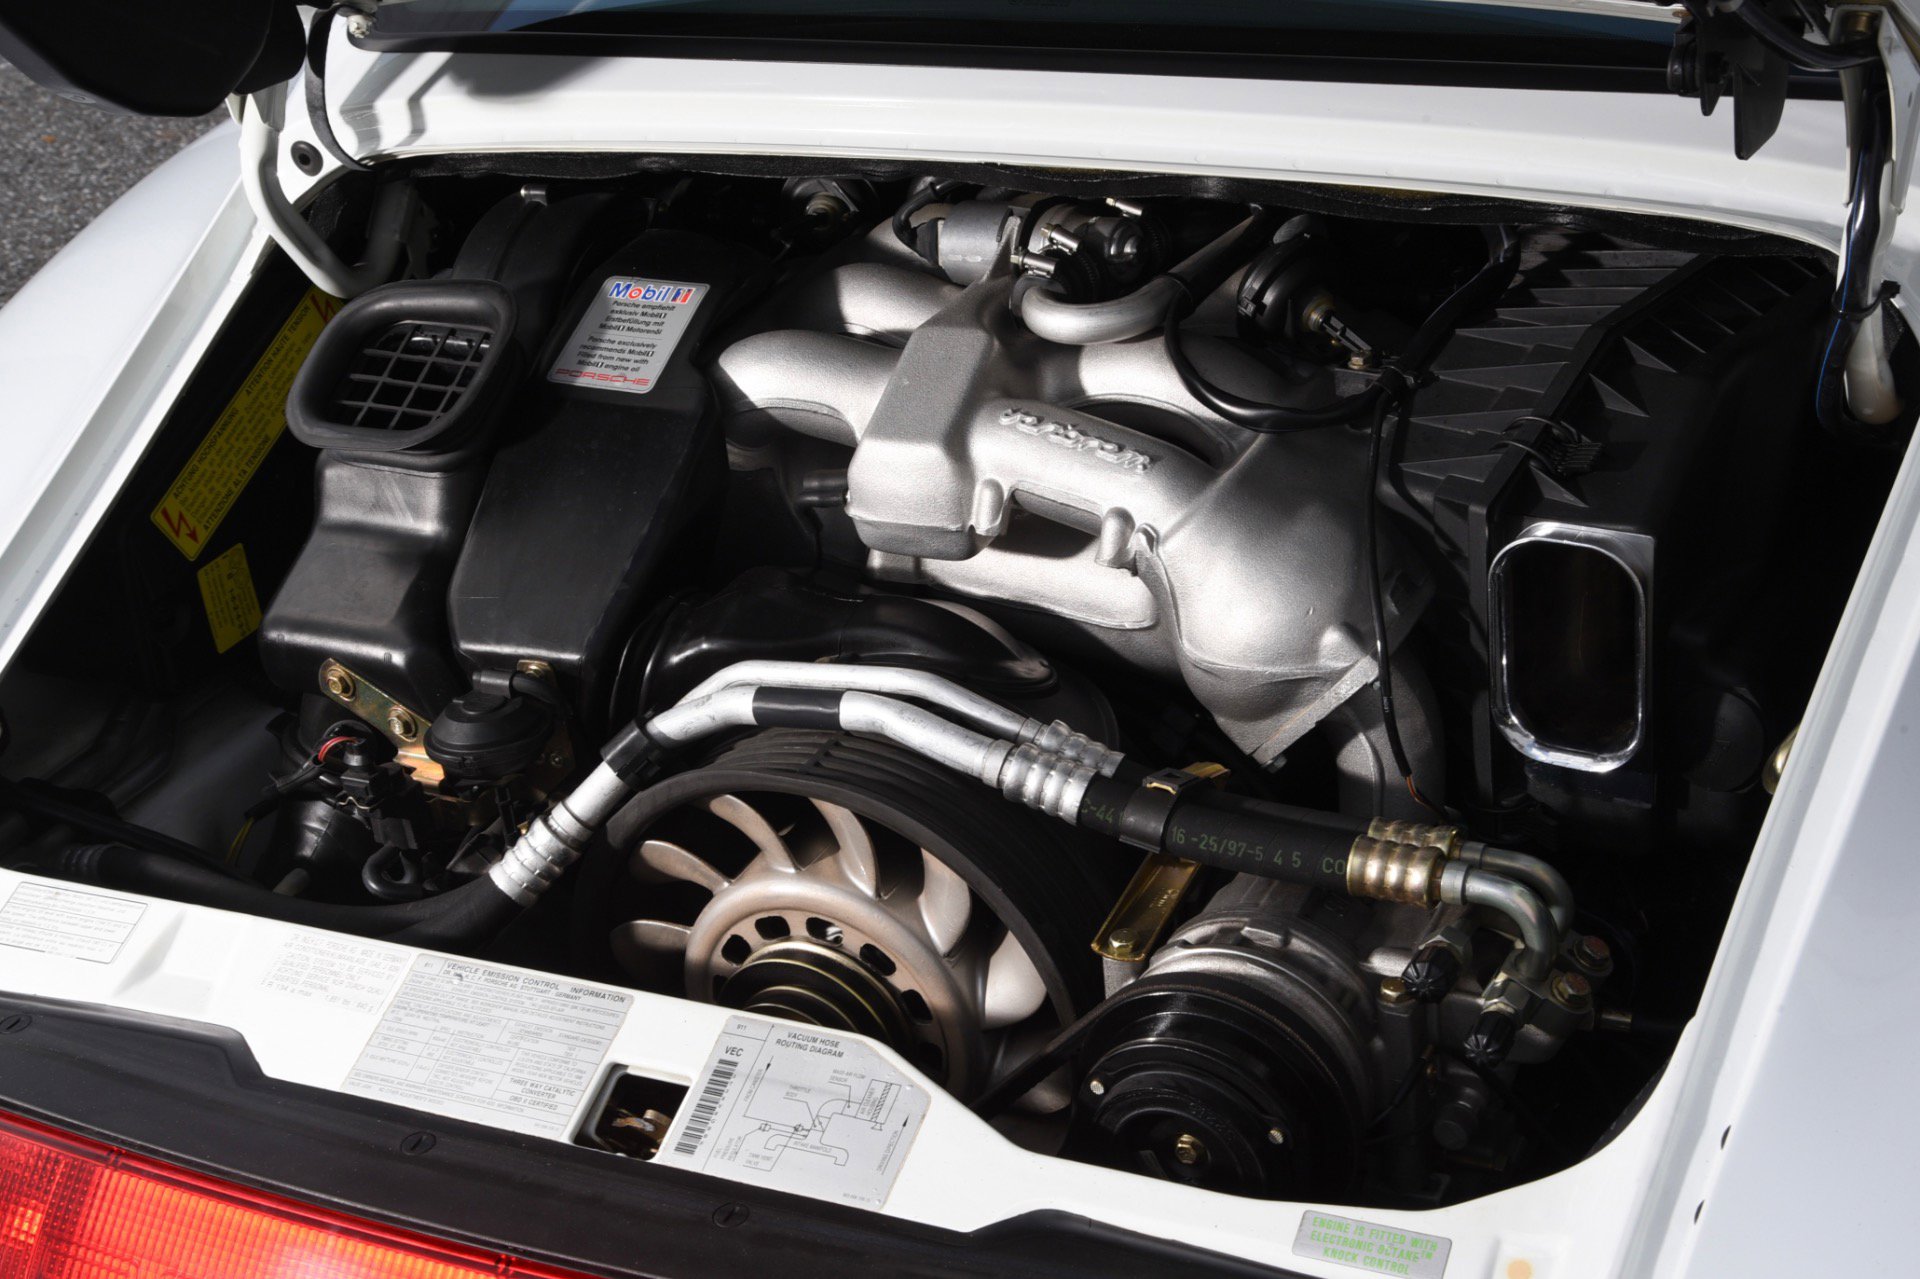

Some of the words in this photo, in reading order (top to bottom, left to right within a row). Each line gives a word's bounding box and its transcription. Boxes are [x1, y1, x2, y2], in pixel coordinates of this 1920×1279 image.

[609, 282, 672, 301] Mobil
[610, 309, 638, 317] exklusiv
[612, 301, 640, 309] Porsche
[579, 345, 626, 354] recommends
[588, 336, 616, 344] Porsche
[617, 339, 657, 349] exclusively
[556, 368, 650, 386] PORSCHE
[1273, 850, 1284, 866] 4
[1291, 852, 1302, 869] 5
[446, 962, 481, 975] VEHICLE
[482, 968, 520, 982] EMISSION
[522, 976, 560, 991] CONTROL
[570, 986, 627, 1003] INFORMATION
[736, 1023, 748, 1031] 911
[775, 1038, 808, 1052] ROUTING
[809, 1044, 844, 1059] DIAGRAM
[786, 1031, 819, 1046] VACUUM
[819, 1037, 841, 1049] HOSE
[724, 1045, 744, 1058] VEC
[509, 1077, 530, 1089] THREE
[531, 1082, 543, 1091] WAY
[543, 1084, 576, 1097] CATALYTIC
[521, 1087, 556, 1100] CONVERTER
[509, 1095, 521, 1104] OBD
[528, 1099, 559, 1111] CERTIFIED
[1310, 1231, 1374, 1253] ELECTRONIC
[1312, 1216, 1351, 1233] ENGINE
[1354, 1225, 1366, 1237] IS
[1369, 1228, 1407, 1245] FITTED
[1411, 1238, 1438, 1251] WITH
[1322, 1247, 1358, 1263] KNOCK
[1363, 1255, 1409, 1275] CONTROL
